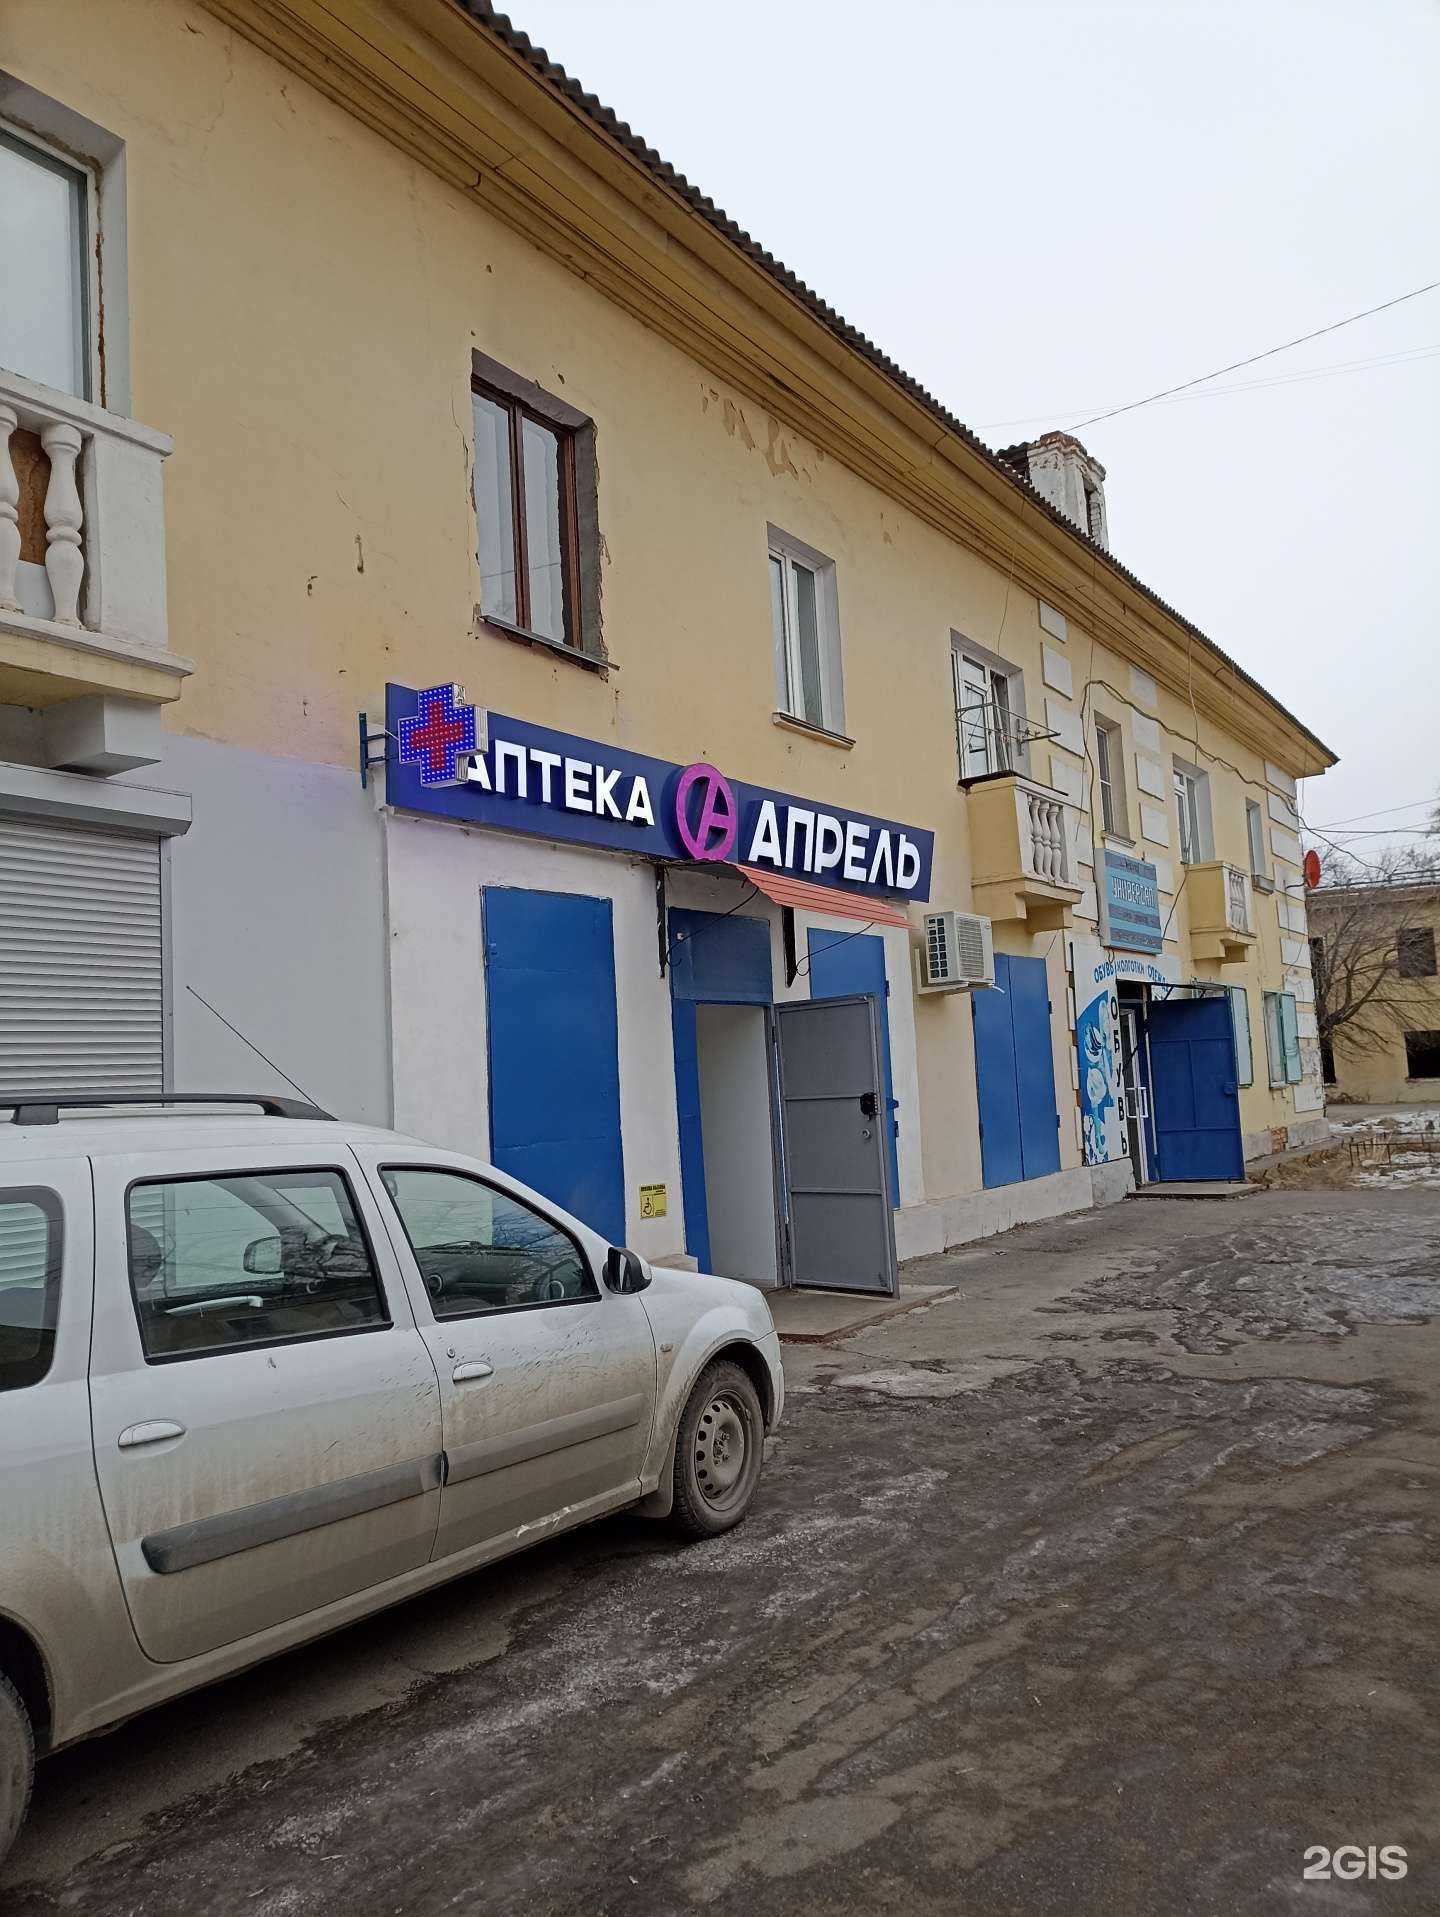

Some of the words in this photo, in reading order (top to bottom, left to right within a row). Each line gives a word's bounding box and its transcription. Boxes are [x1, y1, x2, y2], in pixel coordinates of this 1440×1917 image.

[467, 739, 655, 827] АПТЕКА
[748, 799, 921, 890] АПРЕЛЬ
[1094, 961, 1114, 983] ОБУВЬ
[1110, 996, 1128, 1155] ОБУВЬ
